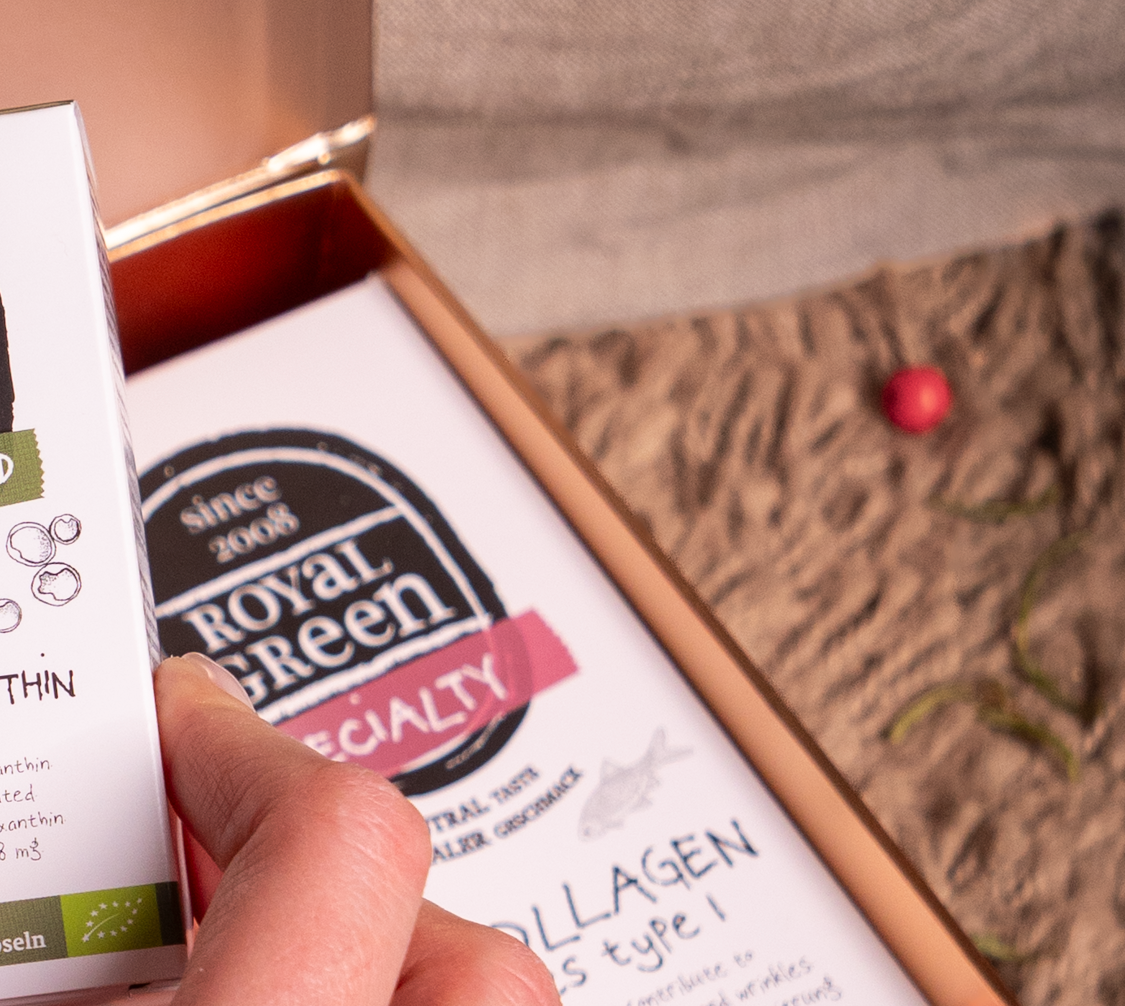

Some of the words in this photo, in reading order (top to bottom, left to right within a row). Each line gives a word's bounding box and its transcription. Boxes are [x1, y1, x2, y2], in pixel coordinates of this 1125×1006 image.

[179, 475, 282, 534] since
[209, 502, 300, 563] 2008
[303, 652, 508, 762] ECIALTY
[15, 837, 43, 862] mg
[601, 912, 701, 974] type
[733, 949, 755, 966] to
[733, 956, 814, 1006] wrinkles
